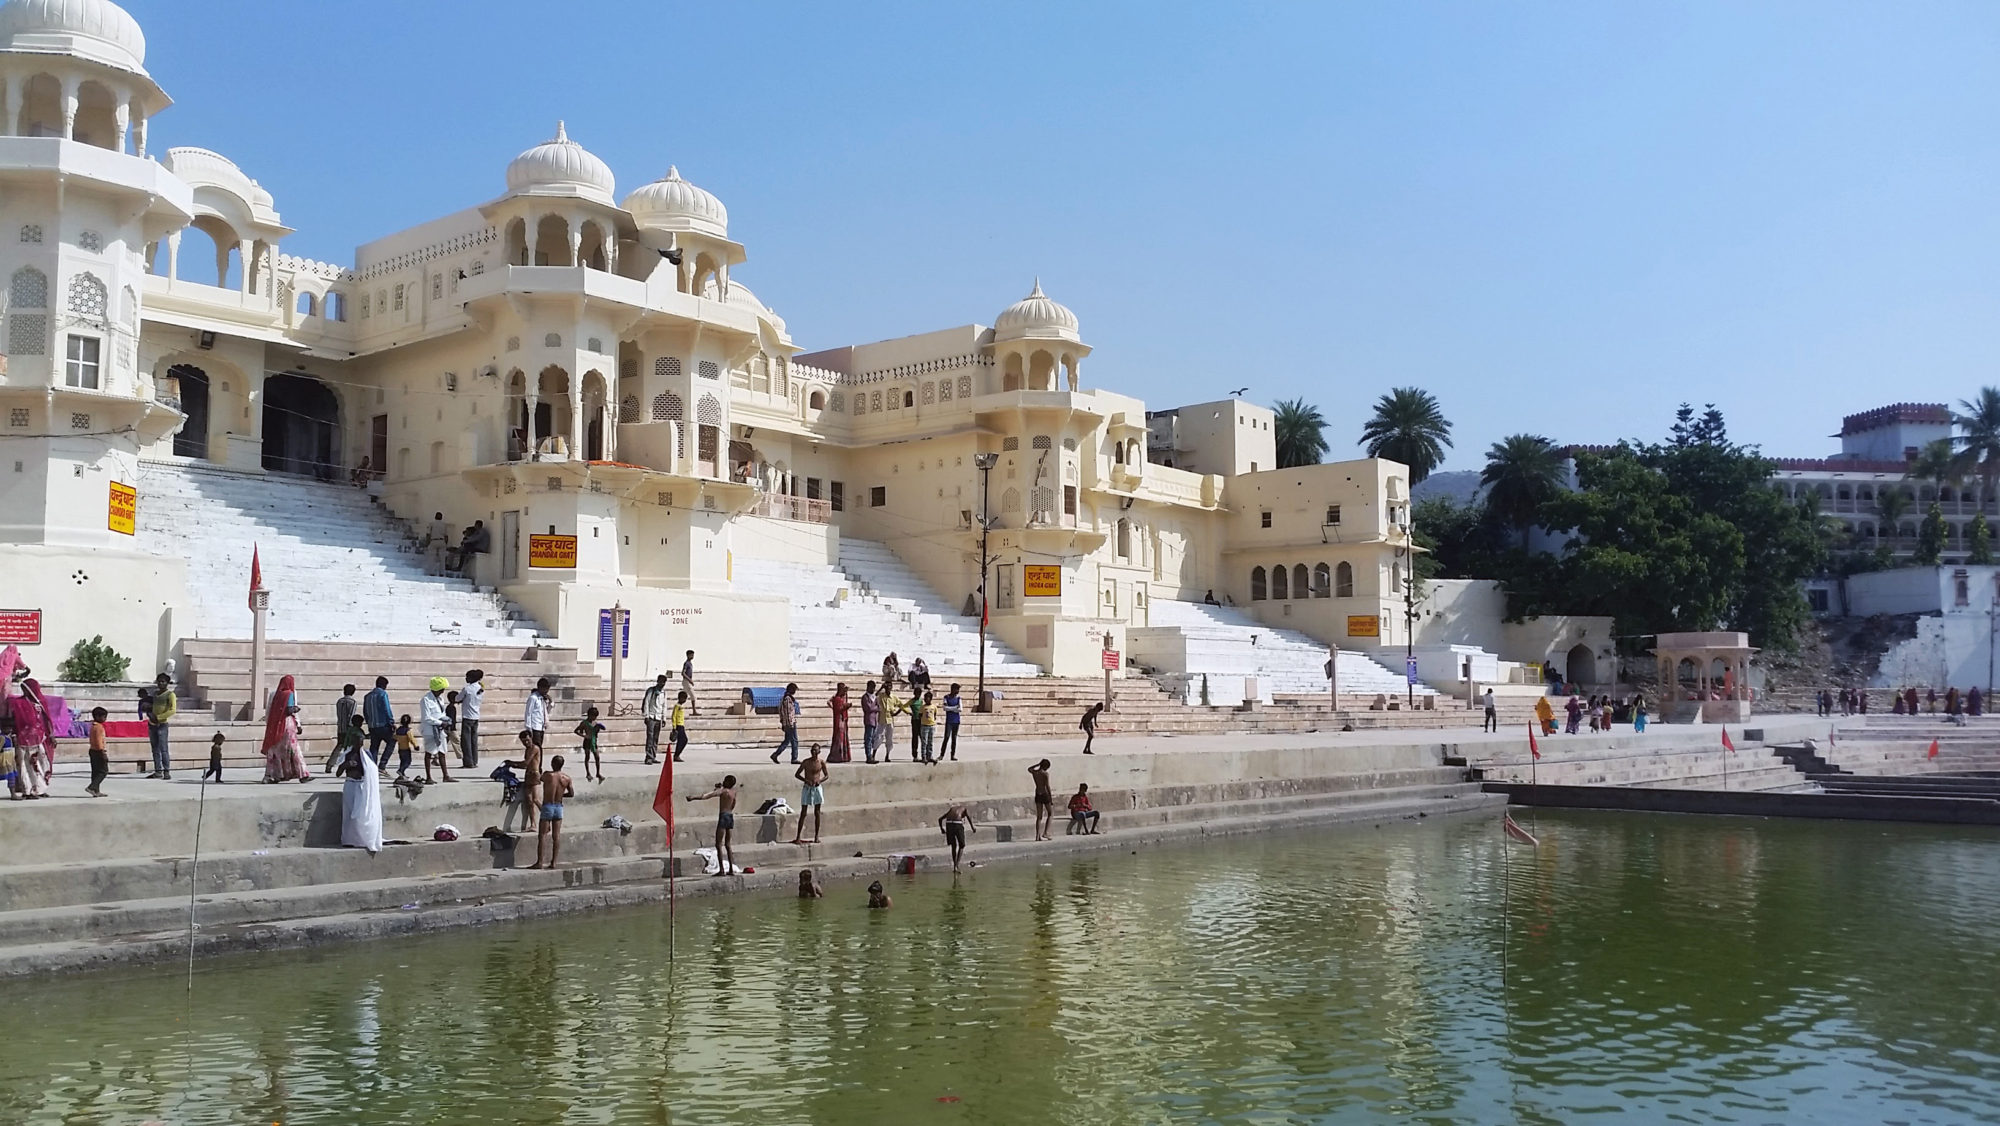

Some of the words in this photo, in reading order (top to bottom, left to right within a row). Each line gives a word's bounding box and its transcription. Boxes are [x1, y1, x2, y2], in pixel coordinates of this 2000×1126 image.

[110, 505, 126, 518] CHANDRA
[126, 509, 135, 520] GHAT
[554, 540, 576, 550] घाट
[531, 551, 558, 559] CHANDRA
[559, 551, 576, 559] GHAT
[670, 608, 703, 616] SMOKING
[672, 617, 689, 625] ZONE
